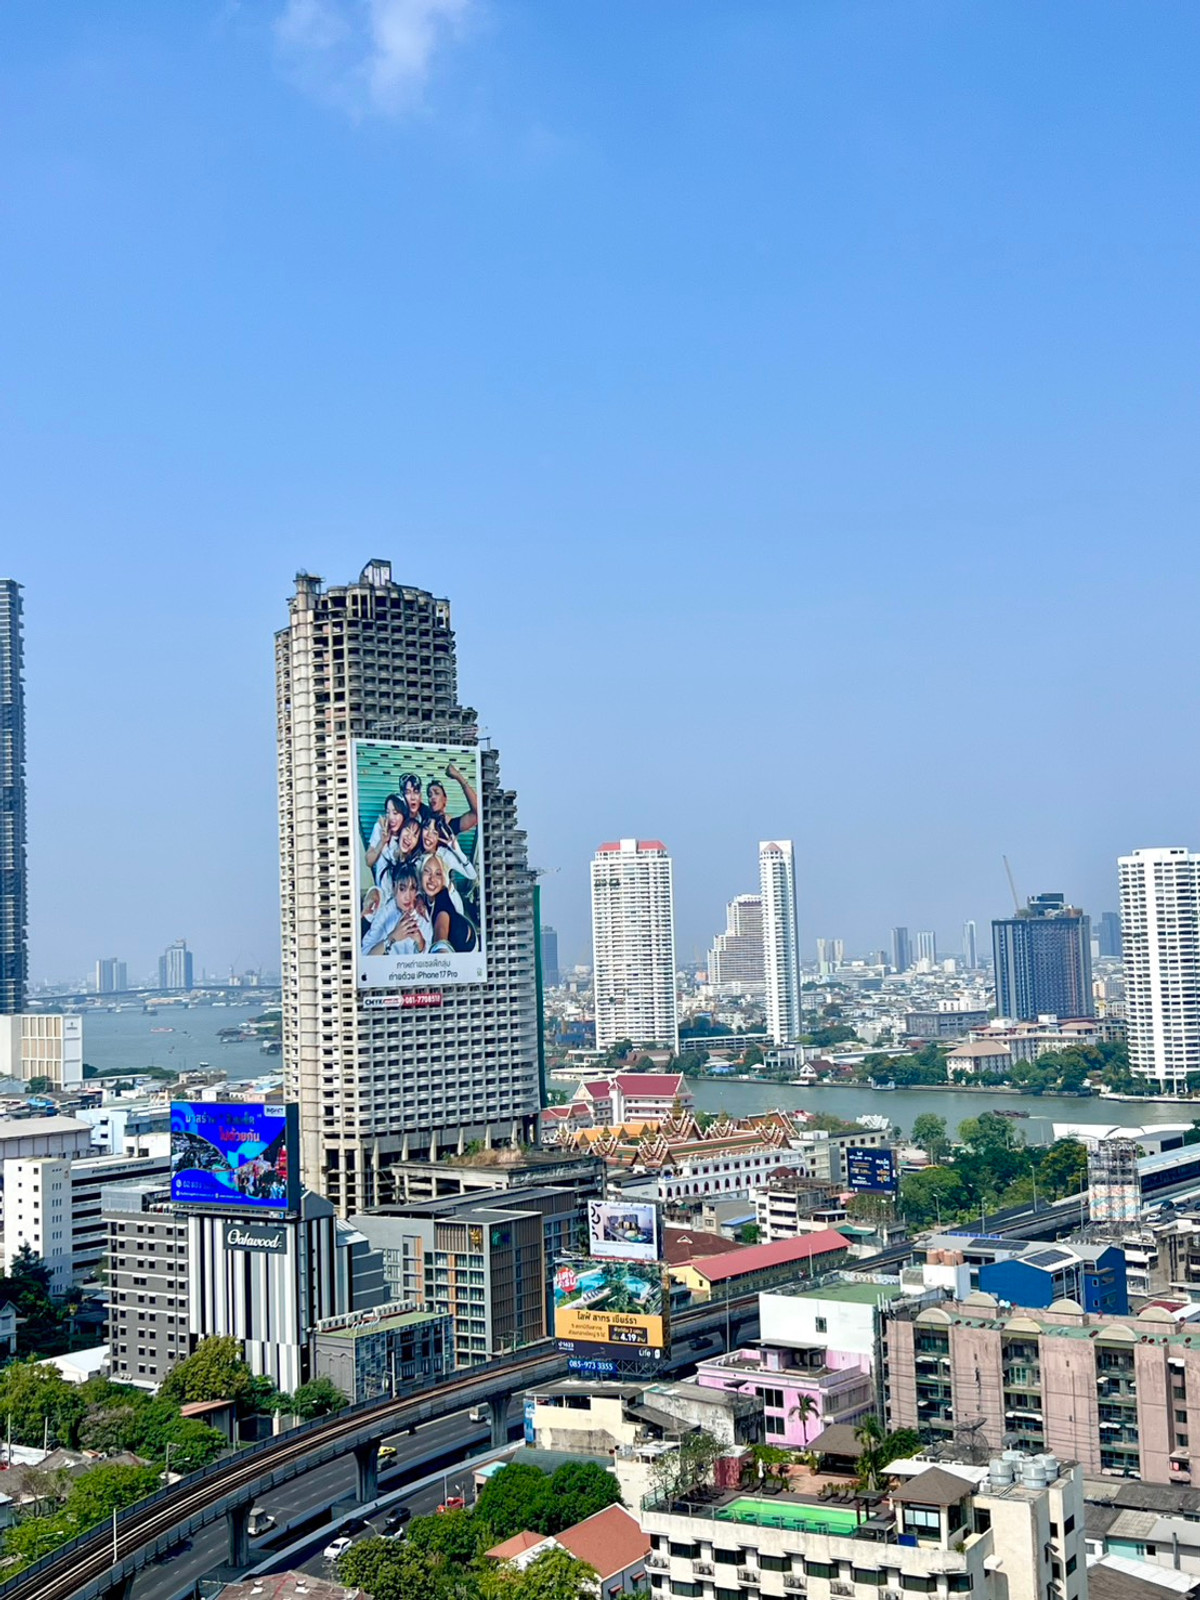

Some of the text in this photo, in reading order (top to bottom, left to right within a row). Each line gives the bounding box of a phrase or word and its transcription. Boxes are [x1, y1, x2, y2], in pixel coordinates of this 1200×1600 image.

[417, 970, 439, 979] iPhone
[447, 970, 458, 978] Pro
[620, 1333, 637, 1342] 4.19
[638, 1348, 651, 1358] Life
